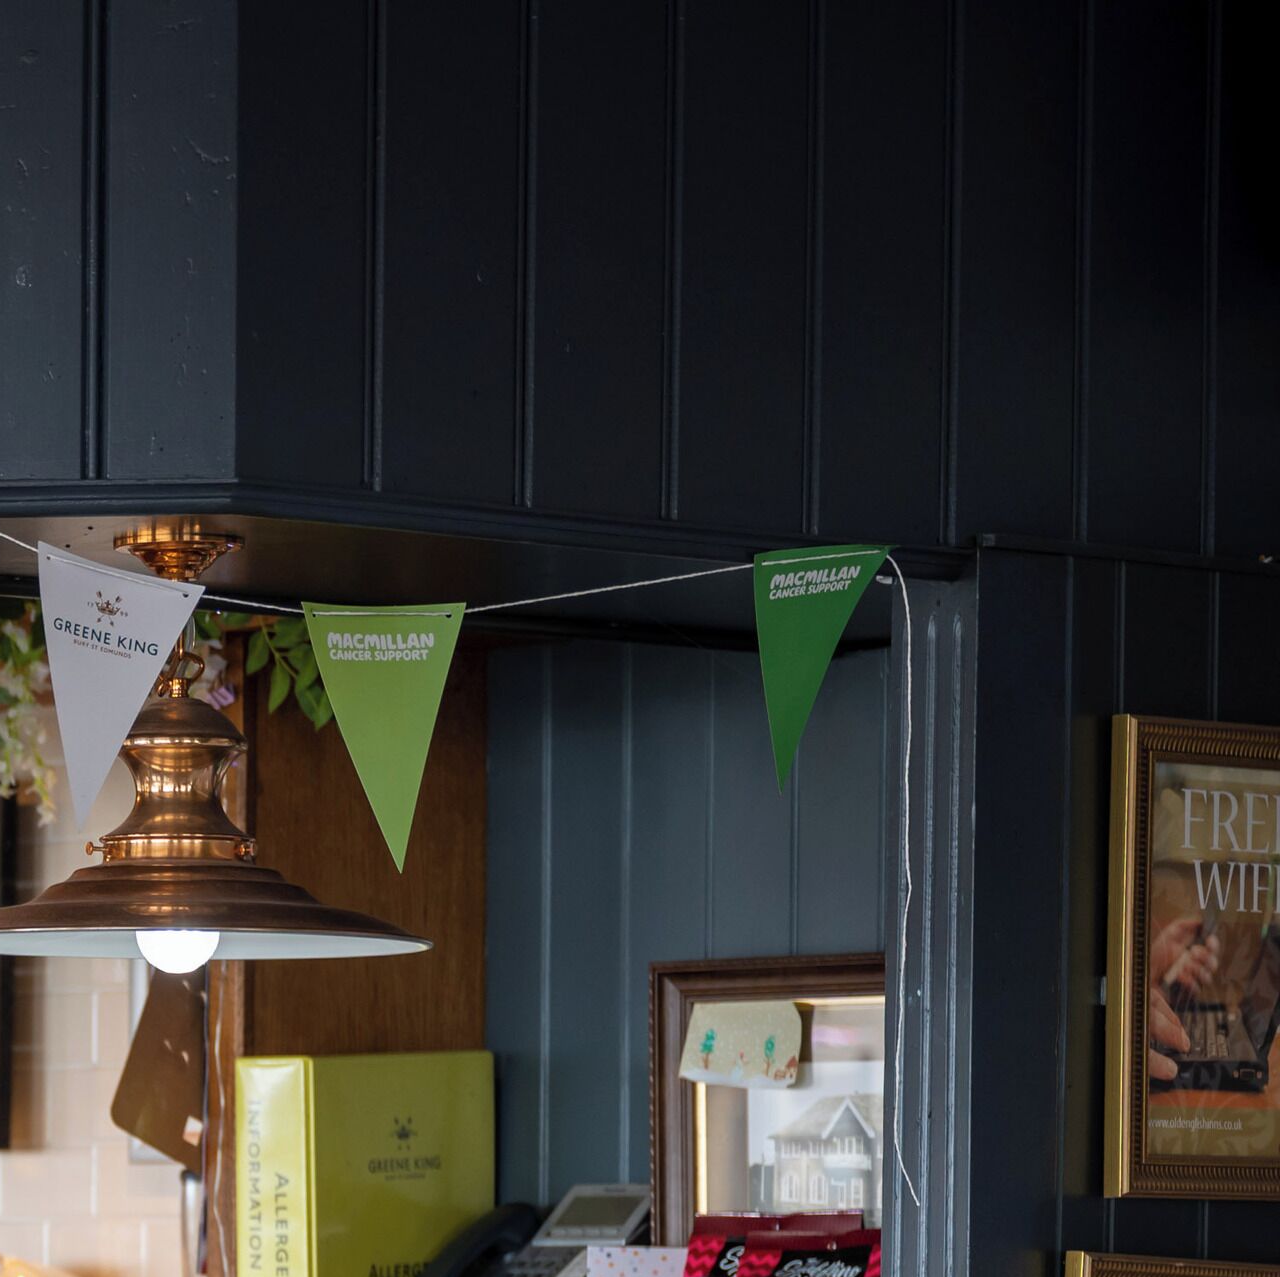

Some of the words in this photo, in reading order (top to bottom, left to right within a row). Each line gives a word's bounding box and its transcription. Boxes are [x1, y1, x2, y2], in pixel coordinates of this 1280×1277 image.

[770, 566, 861, 589] MACMILLAN
[769, 586, 806, 600] CANCER
[807, 580, 851, 594] SUPPORT
[53, 617, 112, 645] GREENE
[117, 635, 159, 656] KING
[327, 632, 435, 649] MACMILLAN
[100, 646, 132, 659] EDMUNDS
[330, 649, 372, 660] CANCER
[374, 650, 429, 661] SUPPORT
[1181, 788, 1280, 854] FRE
[414, 1155, 440, 1171] KING
[248, 1100, 261, 1270] INFORMATION
